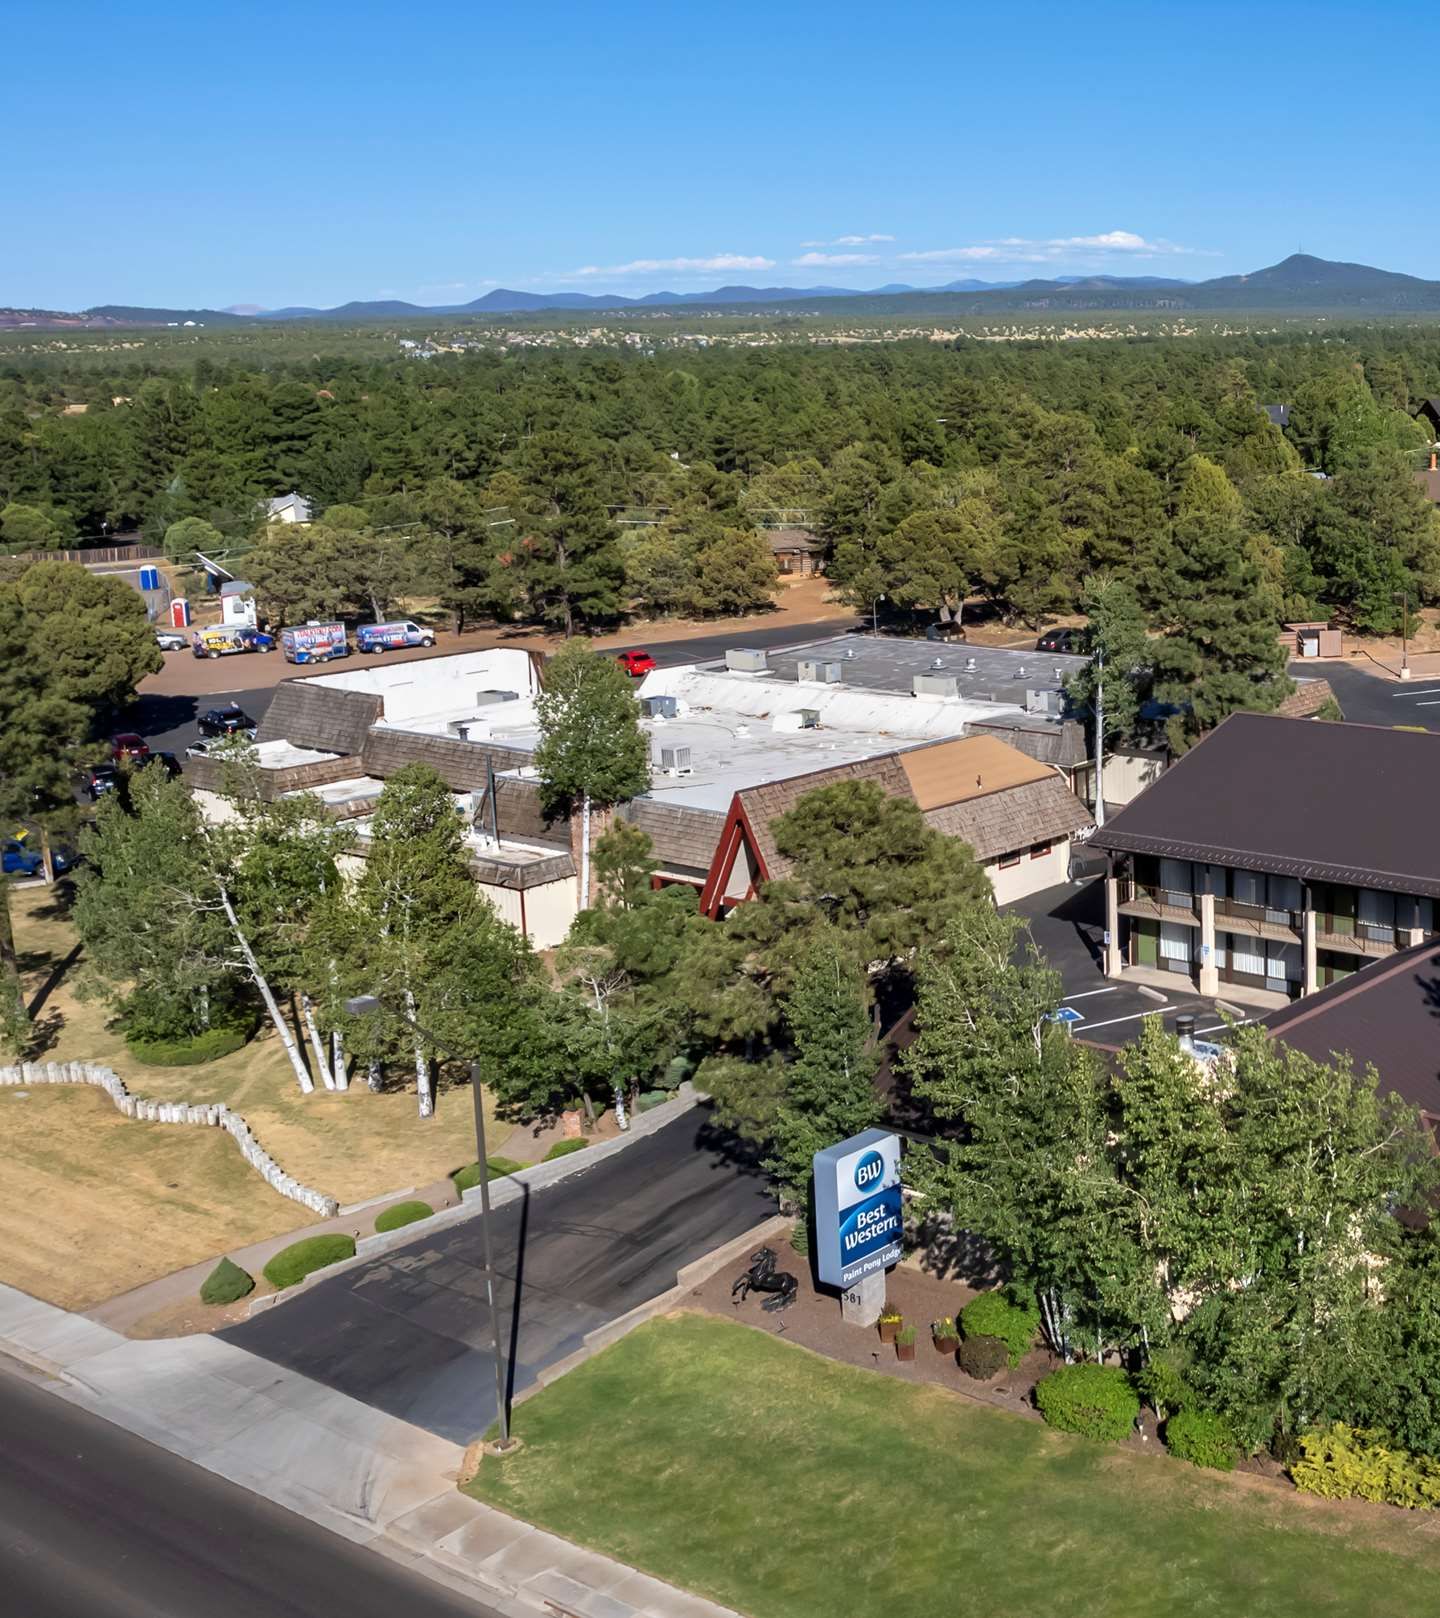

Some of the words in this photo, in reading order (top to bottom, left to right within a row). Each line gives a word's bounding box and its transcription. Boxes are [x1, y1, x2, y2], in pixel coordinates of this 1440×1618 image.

[858, 1159, 881, 1186] BW
[857, 1204, 886, 1229] Best
[845, 1215, 898, 1251] Western
[843, 1267, 863, 1282] Paint
[863, 1258, 881, 1272] Pony
